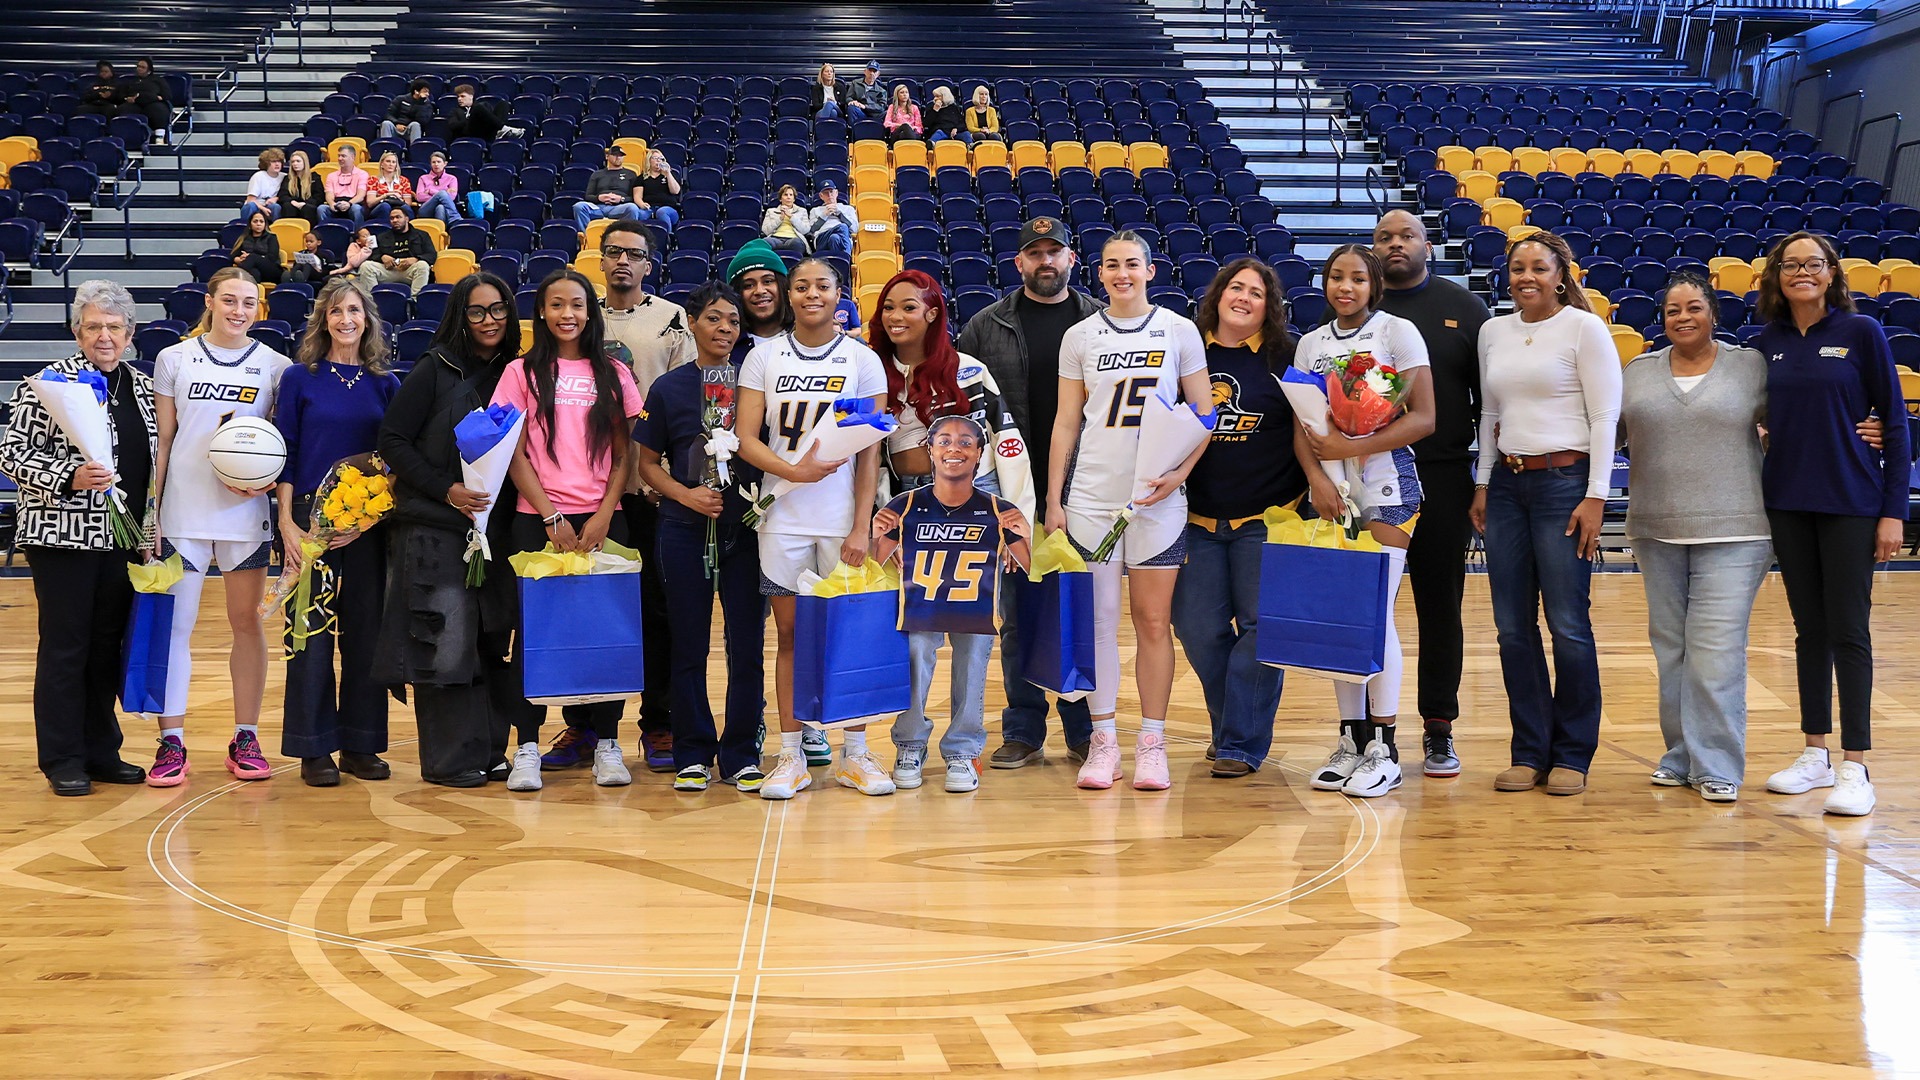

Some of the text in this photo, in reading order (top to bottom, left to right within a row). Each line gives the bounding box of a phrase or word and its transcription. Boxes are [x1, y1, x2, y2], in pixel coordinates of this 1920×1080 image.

[1097, 350, 1165, 372] UNCG
[703, 368, 735, 383] LOVE
[775, 375, 847, 394] UNCG
[188, 382, 260, 404] UNCG
[1105, 376, 1159, 428] 15
[916, 523, 987, 543] UNCG
[912, 550, 990, 602] 45
